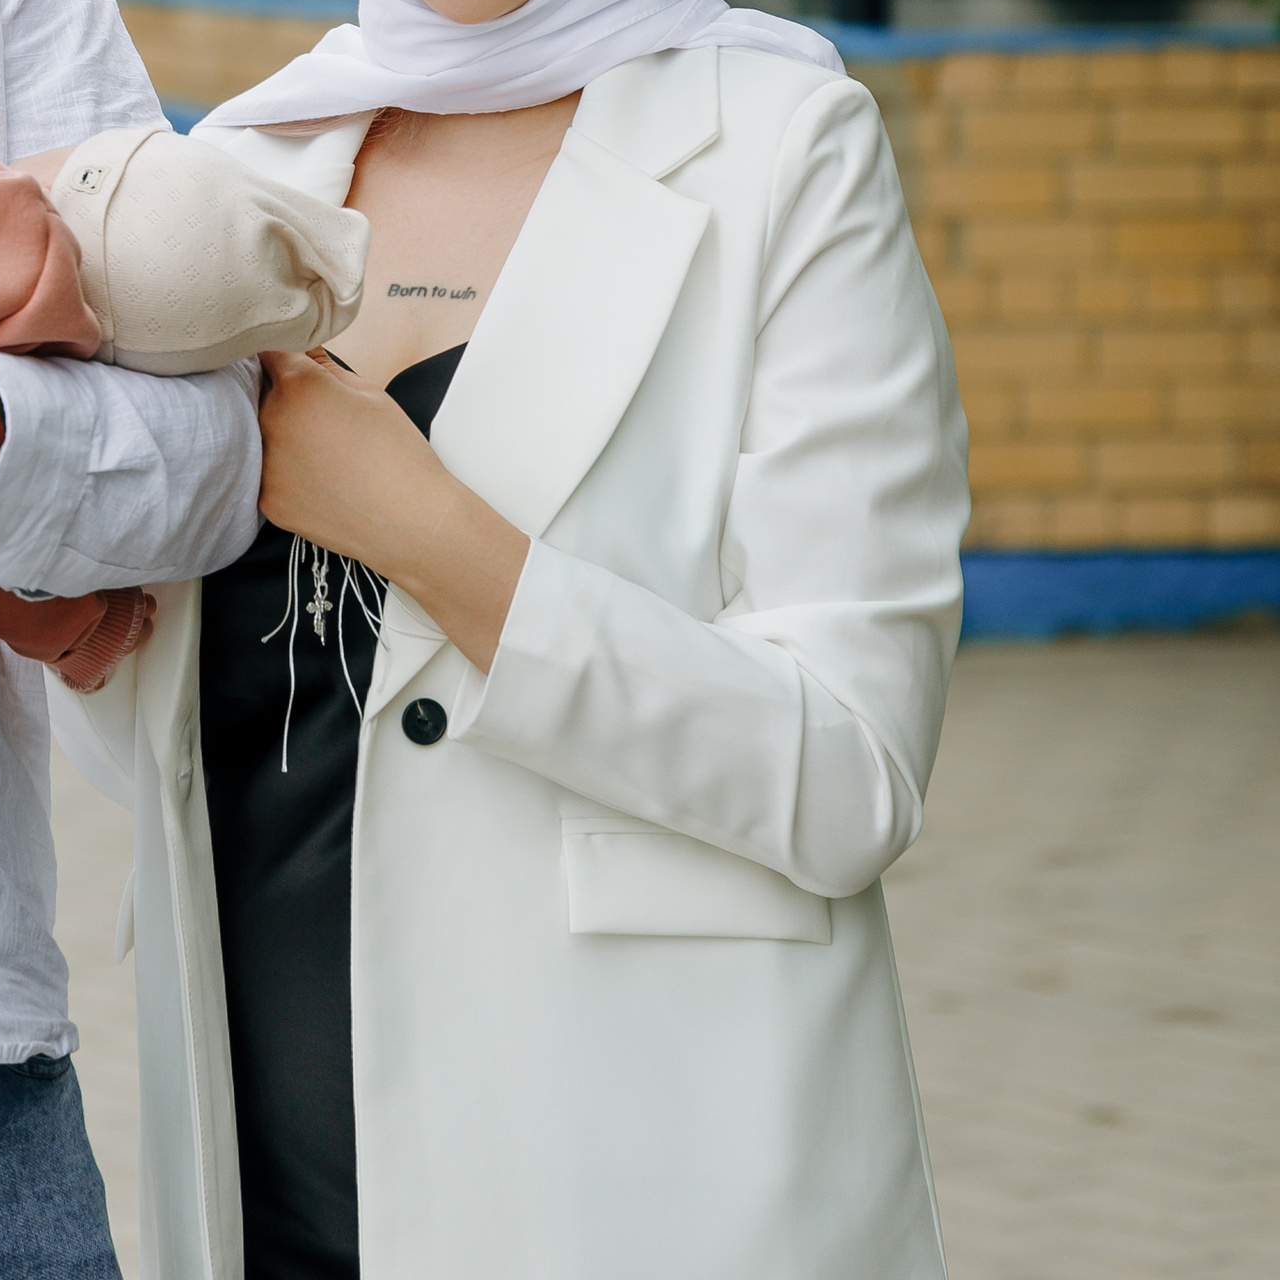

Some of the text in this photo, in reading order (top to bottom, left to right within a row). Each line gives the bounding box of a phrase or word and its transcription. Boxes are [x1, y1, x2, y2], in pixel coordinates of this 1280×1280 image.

[387, 283, 477, 301] Born to win
